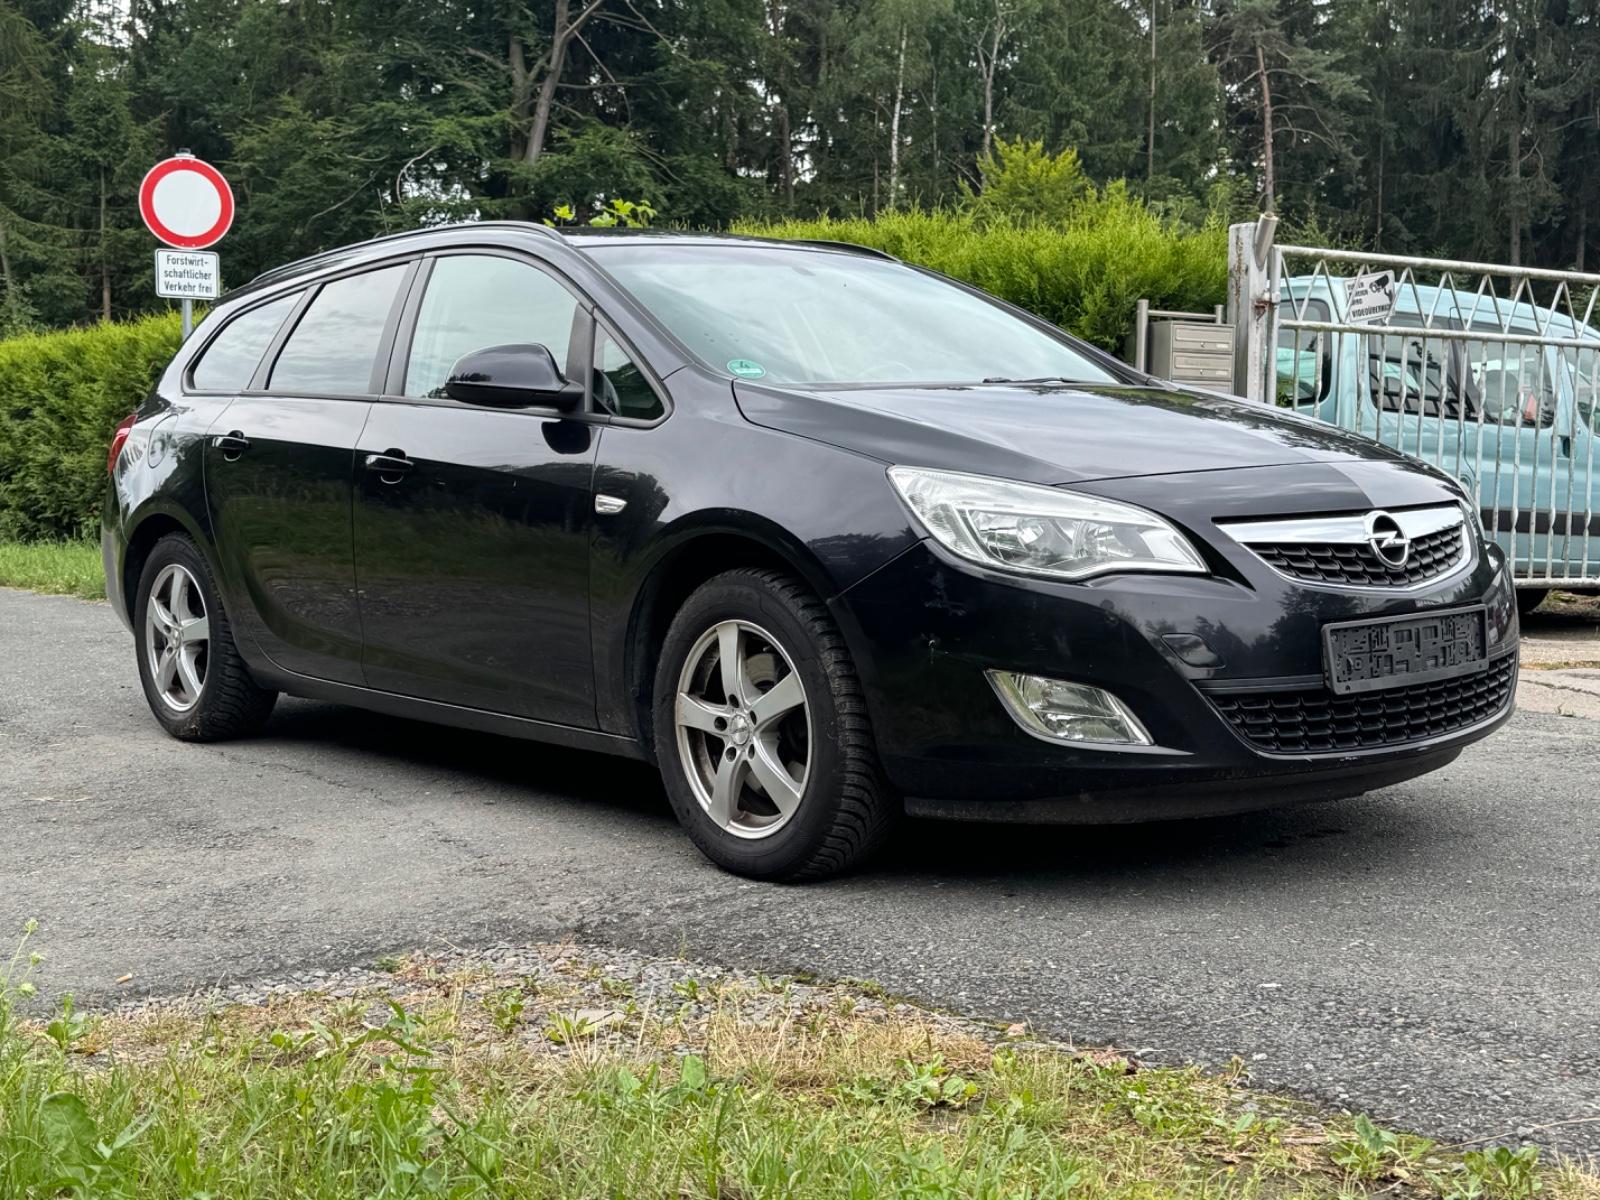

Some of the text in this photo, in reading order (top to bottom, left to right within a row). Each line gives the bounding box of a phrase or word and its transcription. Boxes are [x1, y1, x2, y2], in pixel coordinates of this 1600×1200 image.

[166, 255, 208, 266] Forstwirt-
[164, 269, 212, 280] schaftlicher
[164, 281, 212, 293] Verkehr frei
